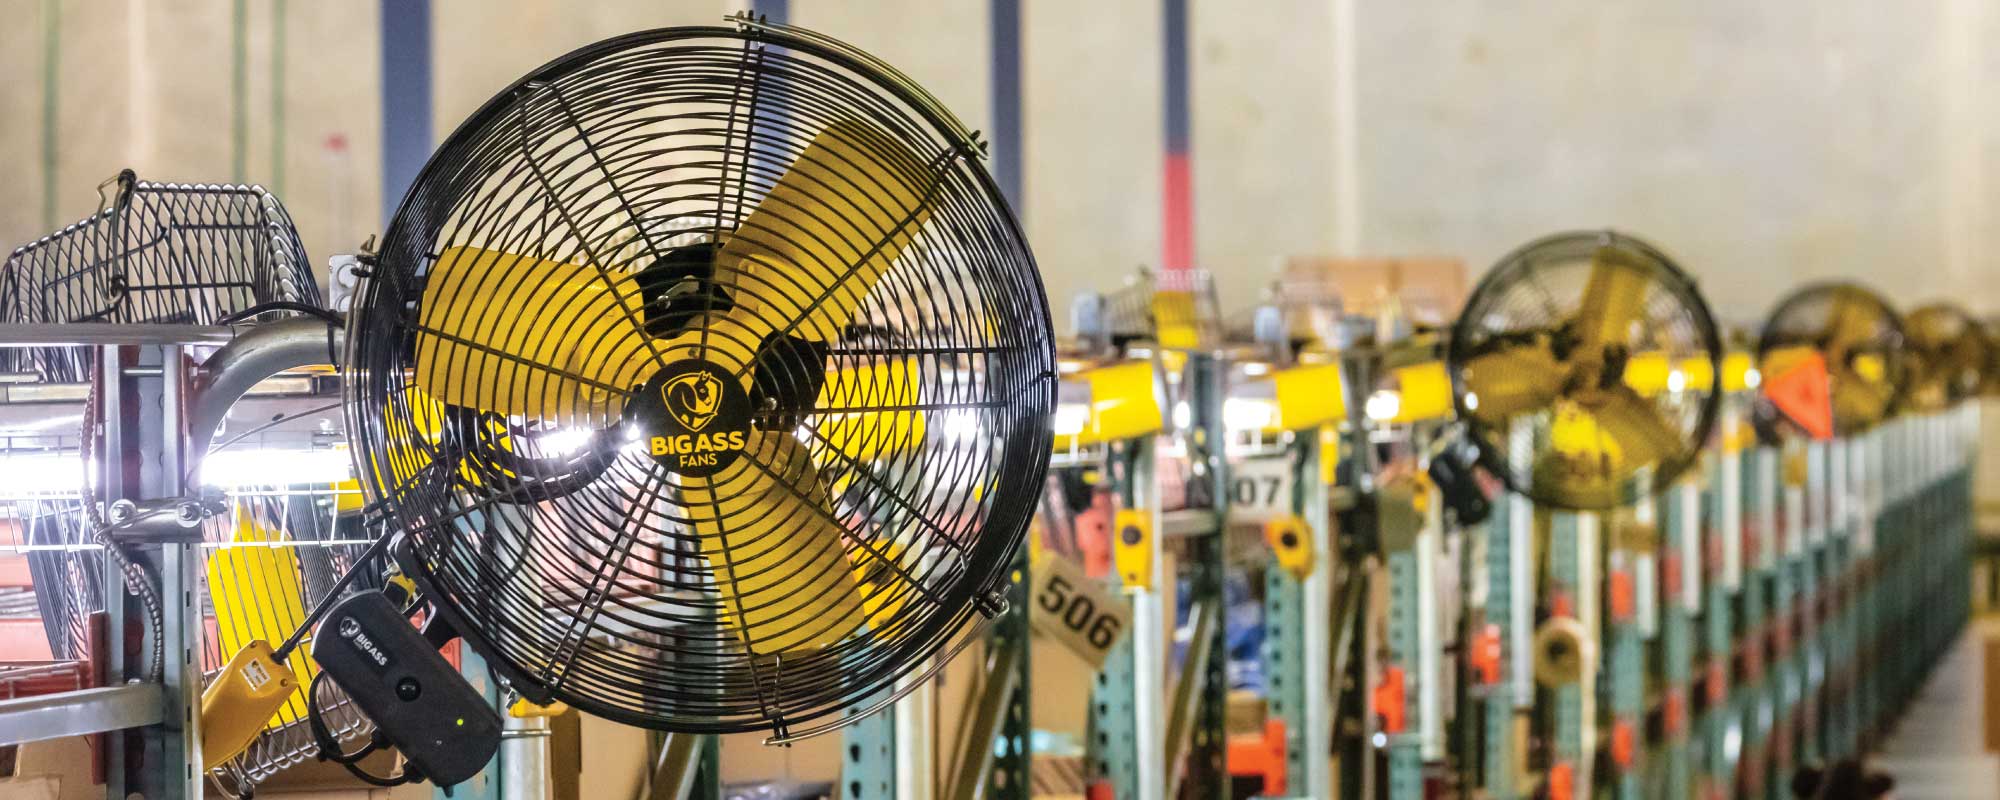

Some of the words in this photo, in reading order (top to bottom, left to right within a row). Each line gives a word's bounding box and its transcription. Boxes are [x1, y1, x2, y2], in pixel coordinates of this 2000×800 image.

[651, 434, 692, 456] BIG
[694, 431, 745, 452] ASS
[680, 453, 717, 467] FANS
[1233, 475, 1281, 507] 07
[1038, 574, 1121, 650] 506
[356, 633, 373, 650] BIG
[368, 647, 388, 666] ASS
